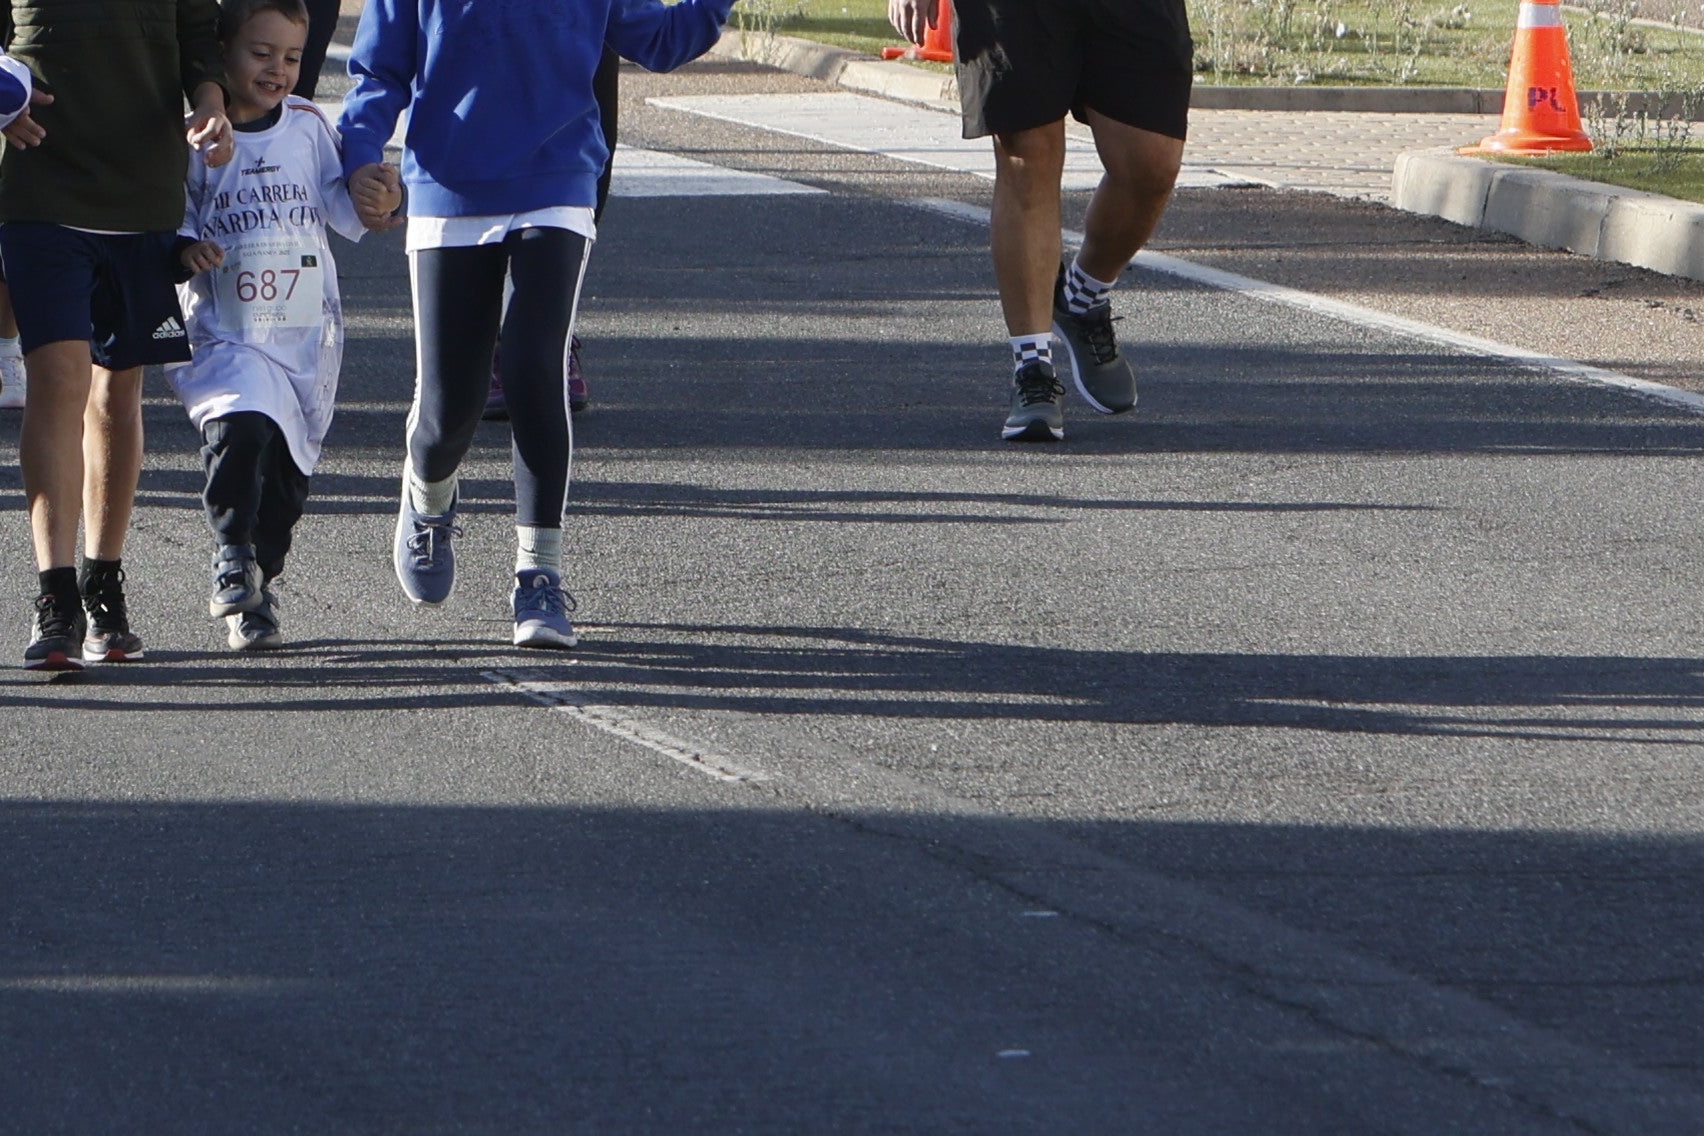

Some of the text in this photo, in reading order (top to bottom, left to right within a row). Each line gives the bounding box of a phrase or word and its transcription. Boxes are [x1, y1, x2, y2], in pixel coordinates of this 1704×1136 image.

[1528, 87, 1566, 113] PL
[213, 183, 308, 211] III CARRERA
[203, 209, 284, 239] VARDIA
[236, 269, 301, 303] 687
